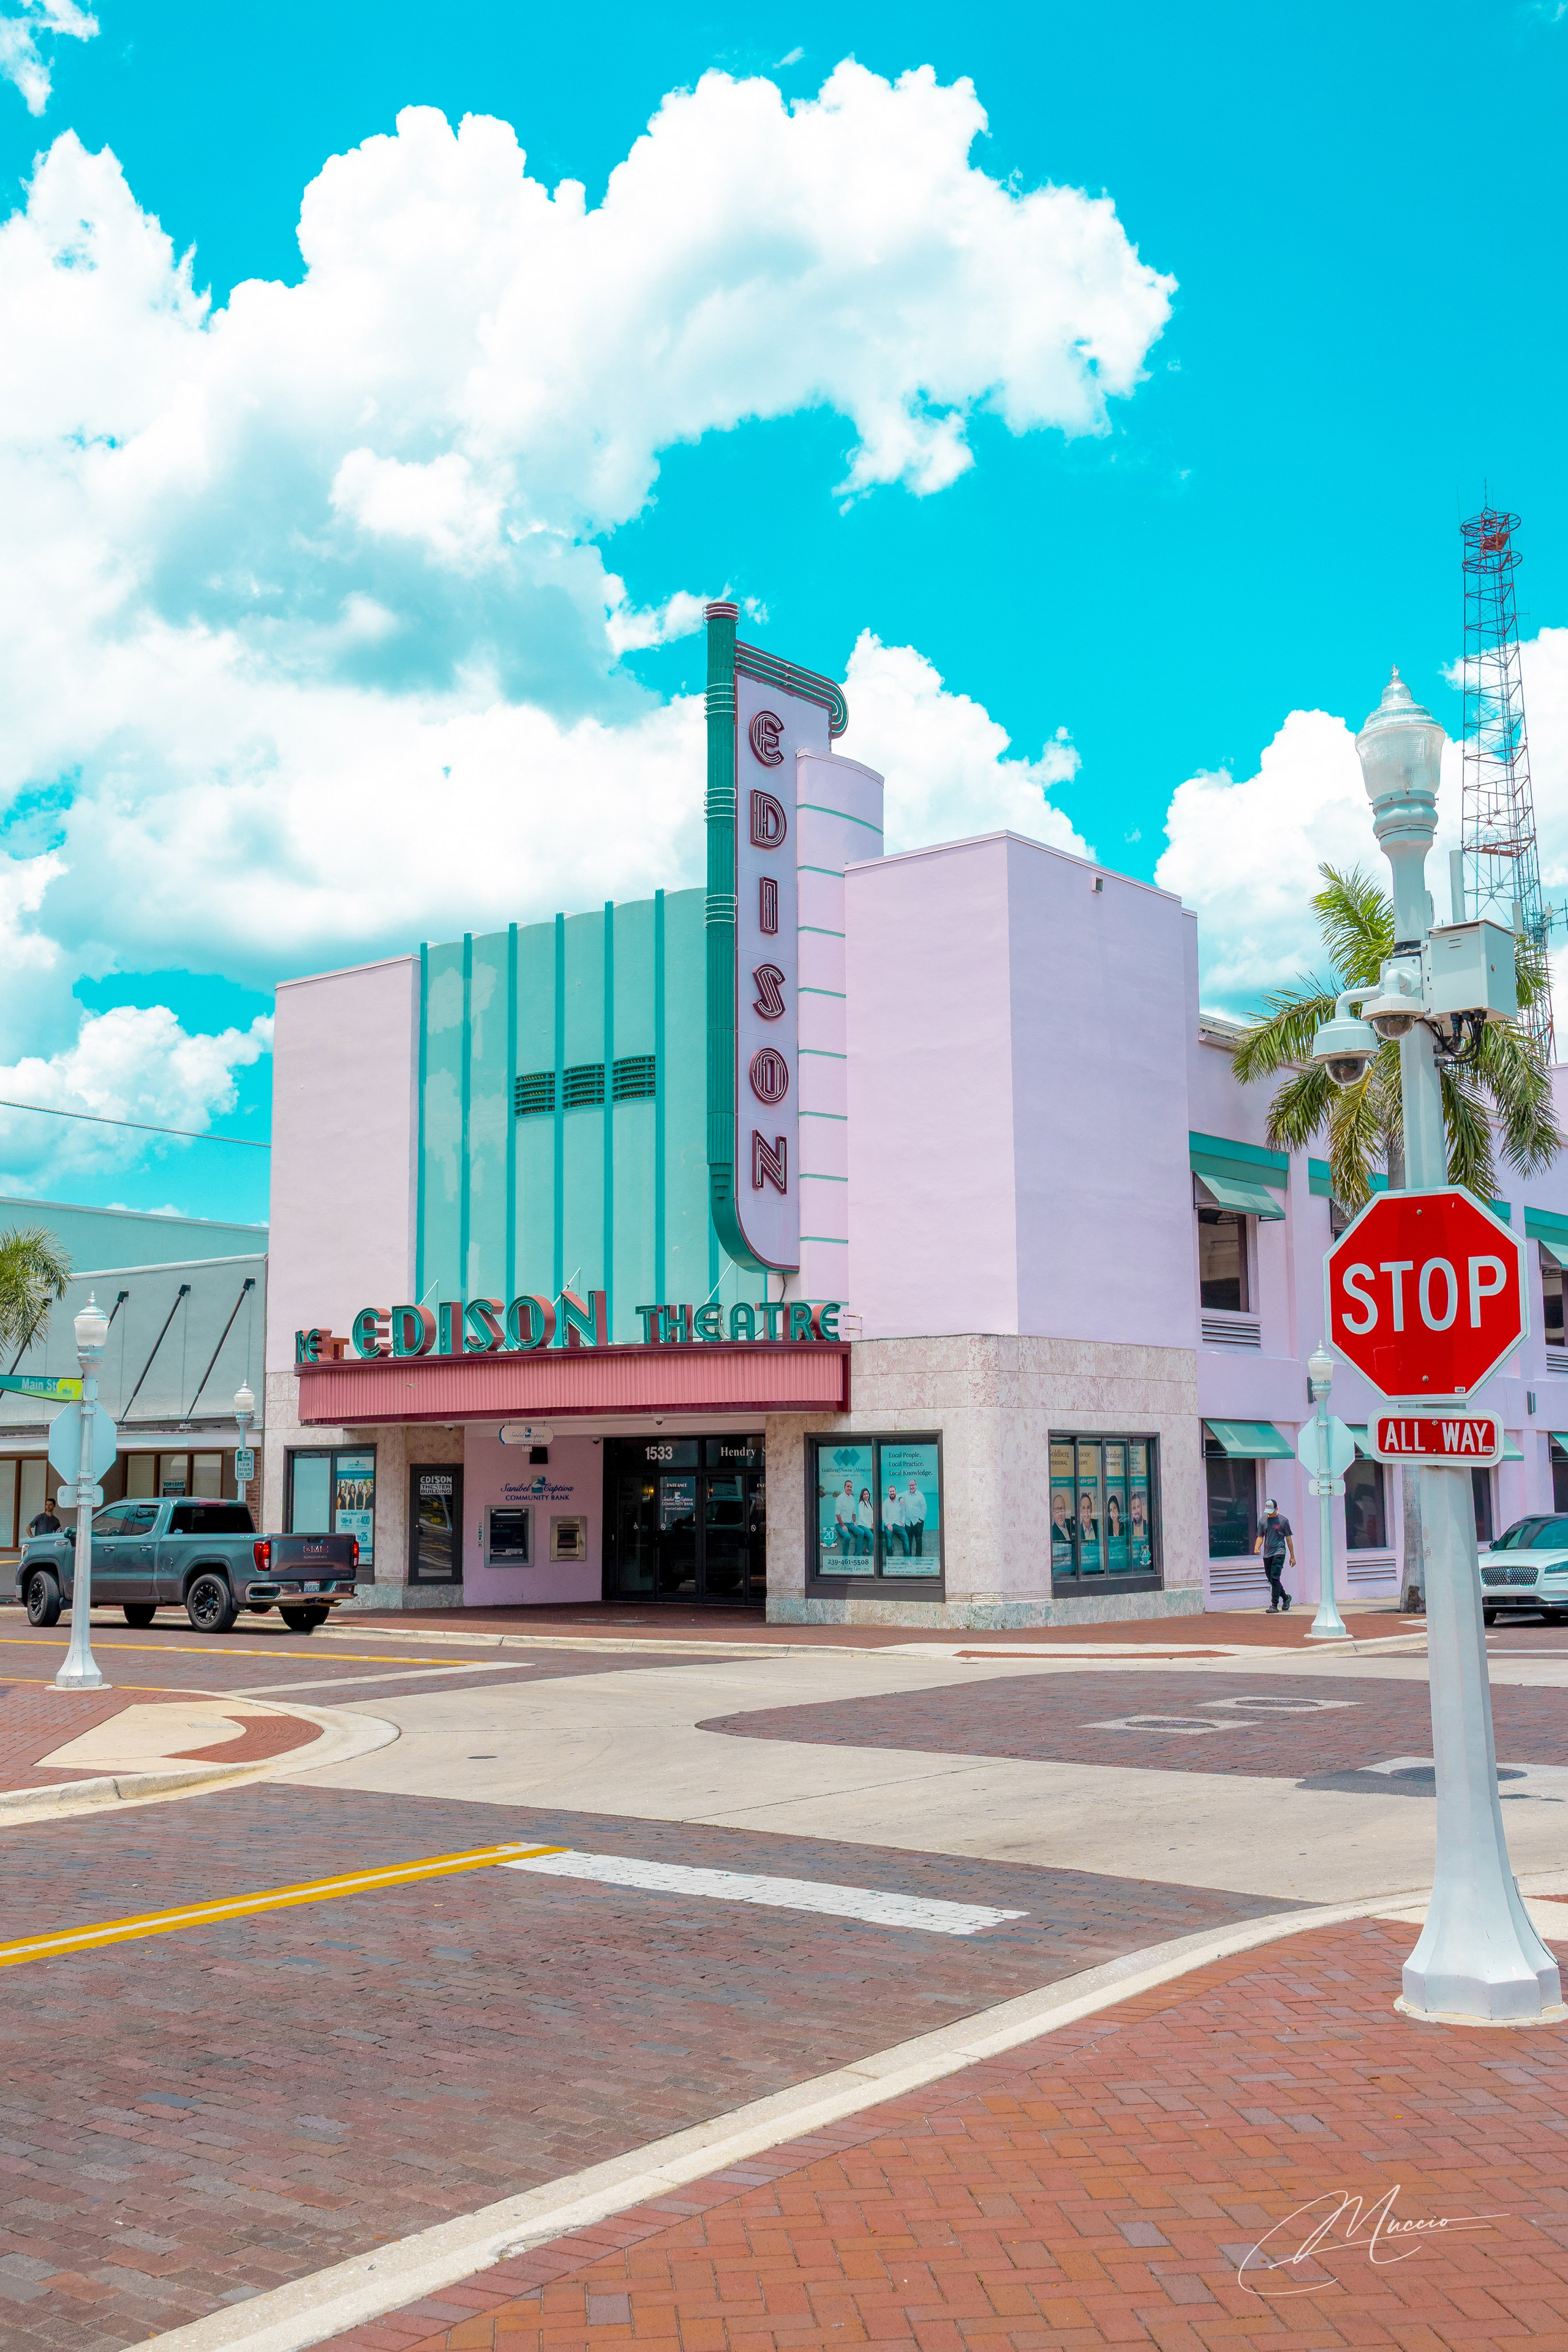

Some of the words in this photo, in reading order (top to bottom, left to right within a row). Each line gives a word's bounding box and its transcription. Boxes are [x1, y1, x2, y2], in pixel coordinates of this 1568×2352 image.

[748, 709, 790, 1196] EDISON
[1342, 1255, 1507, 1335] STOP
[352, 1291, 606, 1358] EDISON
[635, 1302, 841, 1343] THEATRE
[22, 1378, 43, 1390] Main
[1384, 1421, 1426, 1451] ALL
[1442, 1422, 1488, 1452] WAY
[646, 1446, 673, 1460] 1533
[720, 1446, 756, 1459] Hendry
[500, 1483, 532, 1492] Sanibel
[543, 1483, 575, 1494] Captiva
[361, 1515, 370, 1525] 400
[361, 1532, 368, 1542] 25
[823, 1531, 834, 1540] 20
